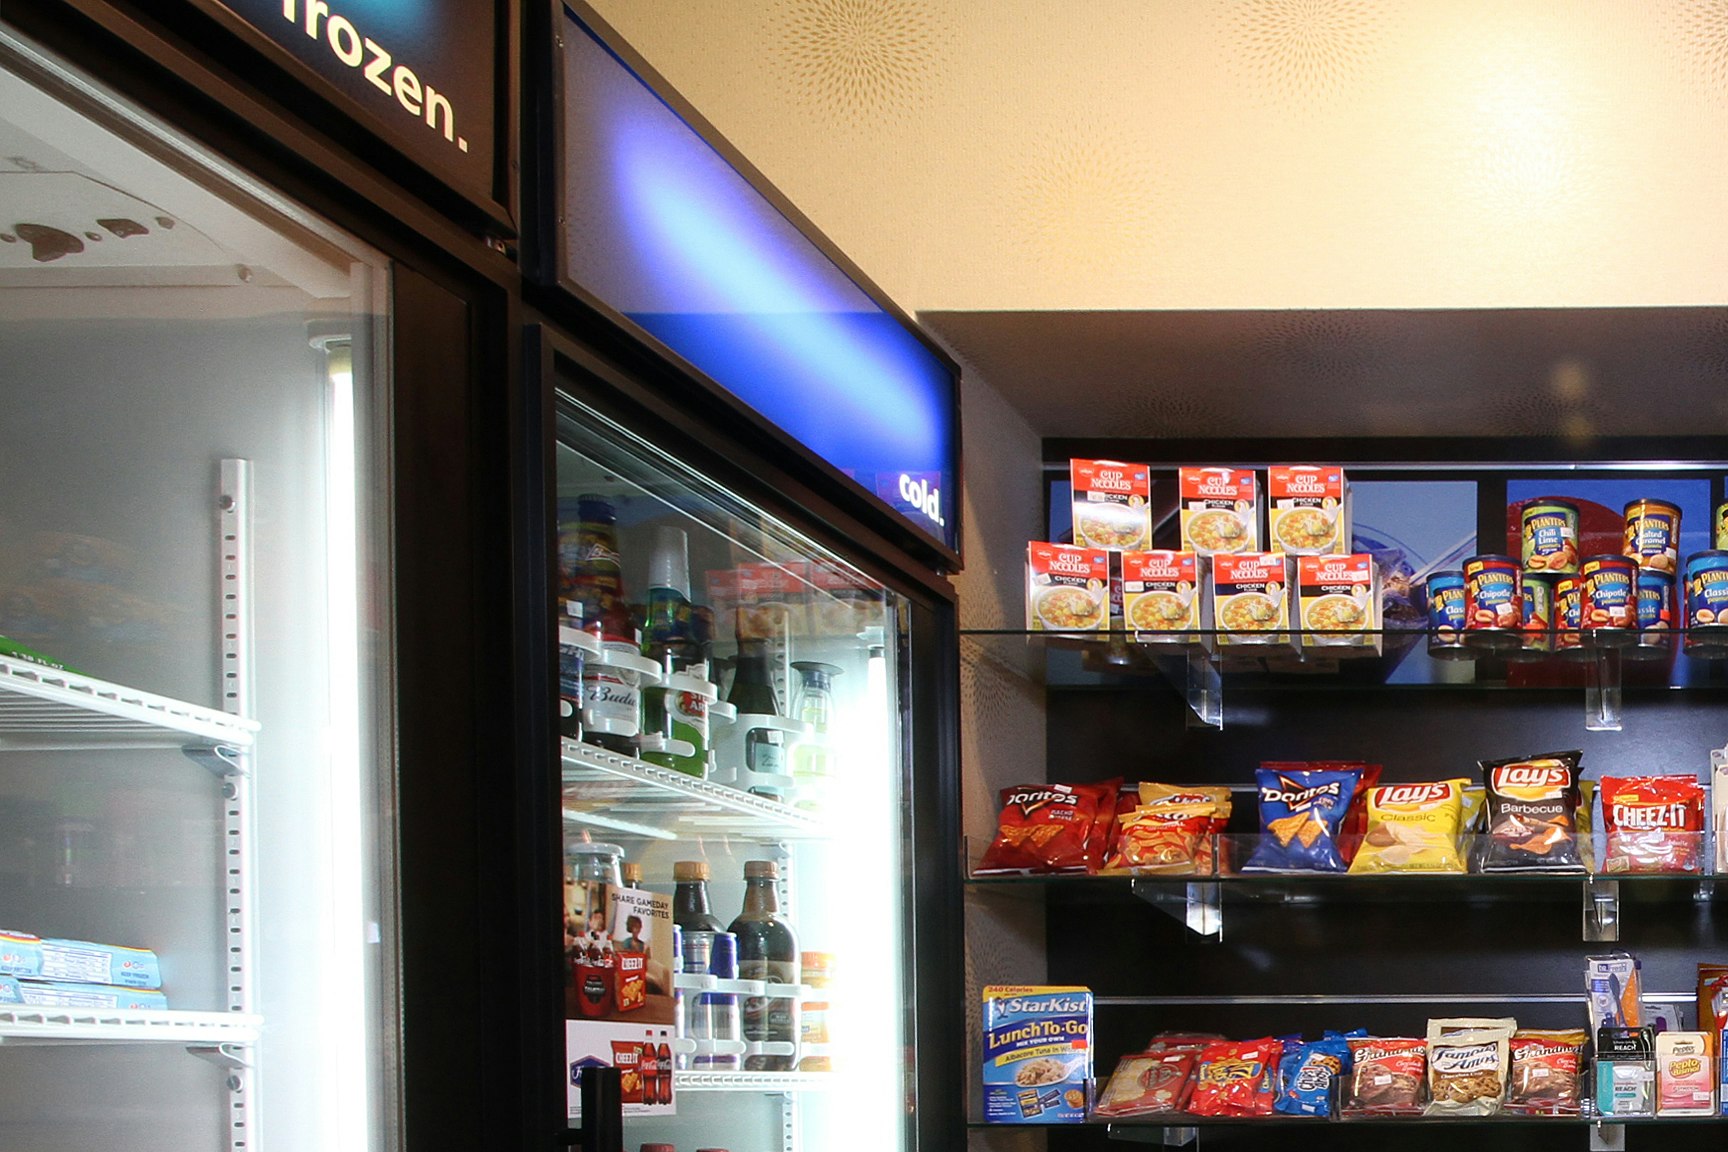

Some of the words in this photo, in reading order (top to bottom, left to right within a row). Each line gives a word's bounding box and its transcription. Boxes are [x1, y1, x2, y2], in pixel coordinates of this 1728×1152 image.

[1101, 471, 1123, 482] CUP
[1207, 476, 1230, 487] CUP
[1296, 475, 1318, 485] CUP
[1090, 478, 1132, 491] NOODLES
[1198, 484, 1238, 496] NOODLES
[1286, 483, 1325, 494] NOODLES
[899, 473, 945, 527] cold.
[1531, 515, 1566, 530] PLANTERS
[1538, 528, 1557, 537] Chili
[1059, 553, 1081, 564] CUP
[1149, 559, 1171, 569] CUP
[1049, 561, 1090, 574] NOODLES
[1239, 561, 1260, 569] CUP
[1325, 563, 1347, 573] CUP
[1140, 567, 1180, 578] NOODLES
[1230, 568, 1268, 580] NOODLES
[1478, 571, 1514, 585] PLANTERS
[1594, 572, 1630, 586] PLANTERS
[1479, 588, 1511, 601] Chipotle
[1596, 588, 1627, 600] Chipotle
[1261, 782, 1340, 803] Doritos
[1501, 803, 1564, 814] Barbecue
[1380, 813, 1436, 823] Classic
[1613, 803, 1687, 828] CHEEZ-IT
[611, 893, 635, 905] SHARE
[636, 898, 669, 910] GAMEDAY
[633, 906, 670, 920] FAVORITES
[1009, 997, 1086, 1013] StarKist
[988, 1023, 1039, 1050] Lunch
[1669, 1058, 1700, 1070] Pepto
